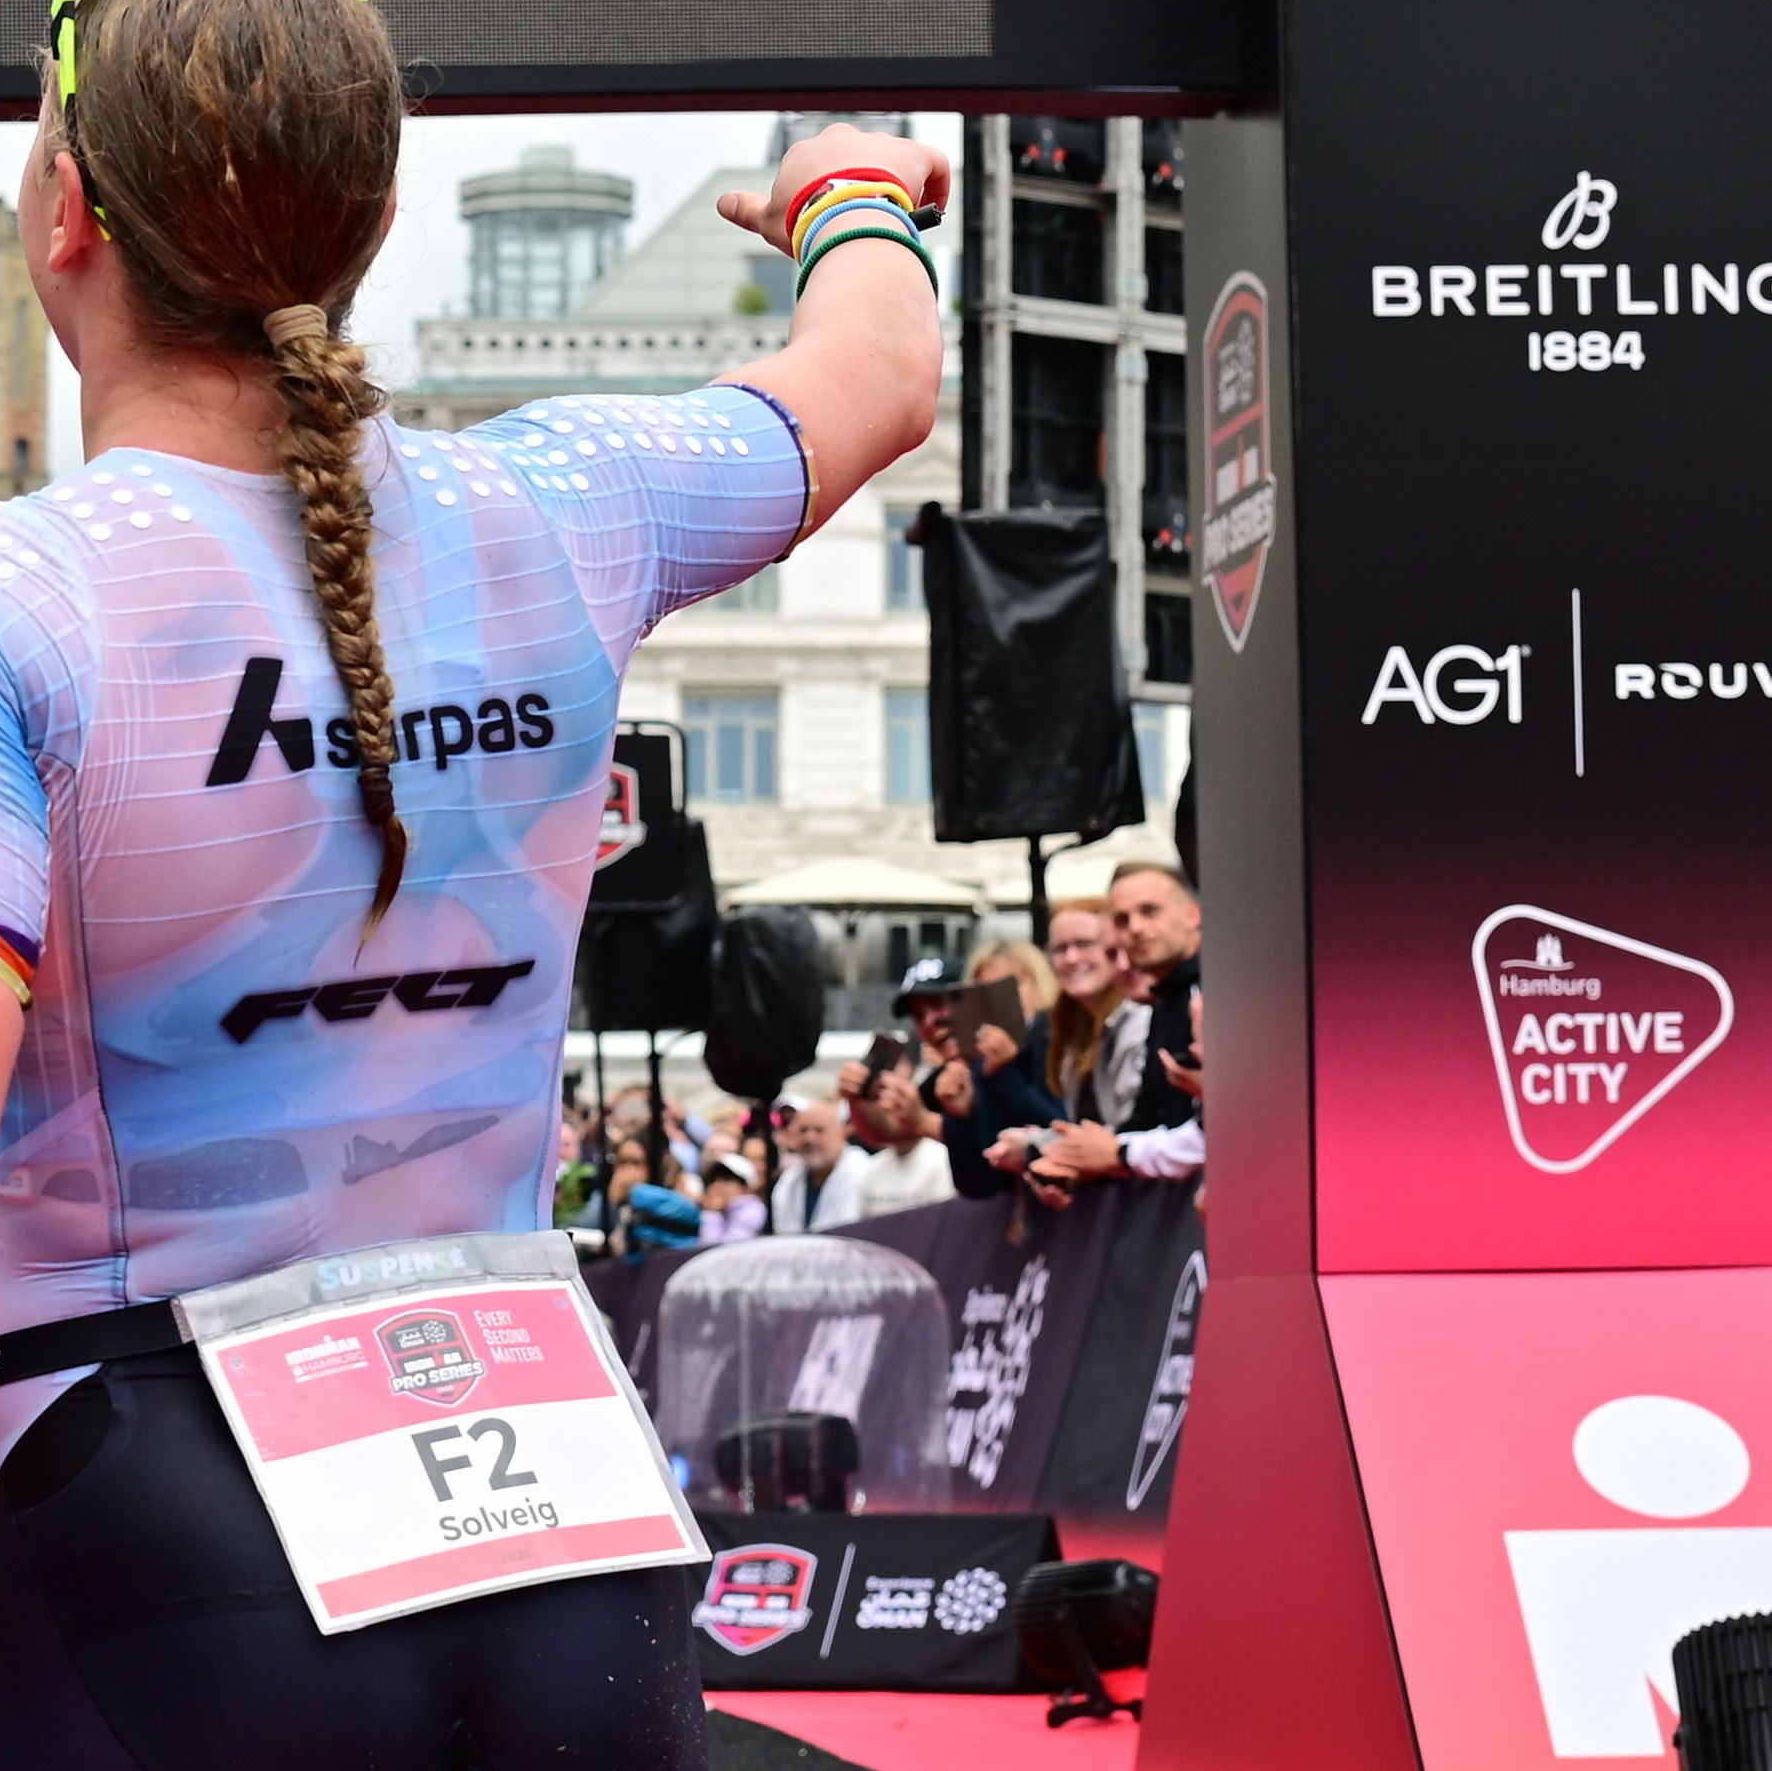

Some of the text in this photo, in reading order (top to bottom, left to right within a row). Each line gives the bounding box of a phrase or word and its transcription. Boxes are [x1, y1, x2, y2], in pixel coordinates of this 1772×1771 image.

[1528, 331, 1646, 371] 1884
[1360, 644, 1525, 726] AG1
[328, 694, 555, 771] srpas
[220, 959, 535, 1045] FELT
[1500, 974, 1601, 1000] Hamburg
[1513, 1012, 1684, 1055] ACTIVE
[1521, 1062, 1628, 1105] CITY
[392, 1361, 484, 1392] PRO SERIES
[411, 1417, 538, 1502] F2
[439, 1498, 559, 1541] Solveig
